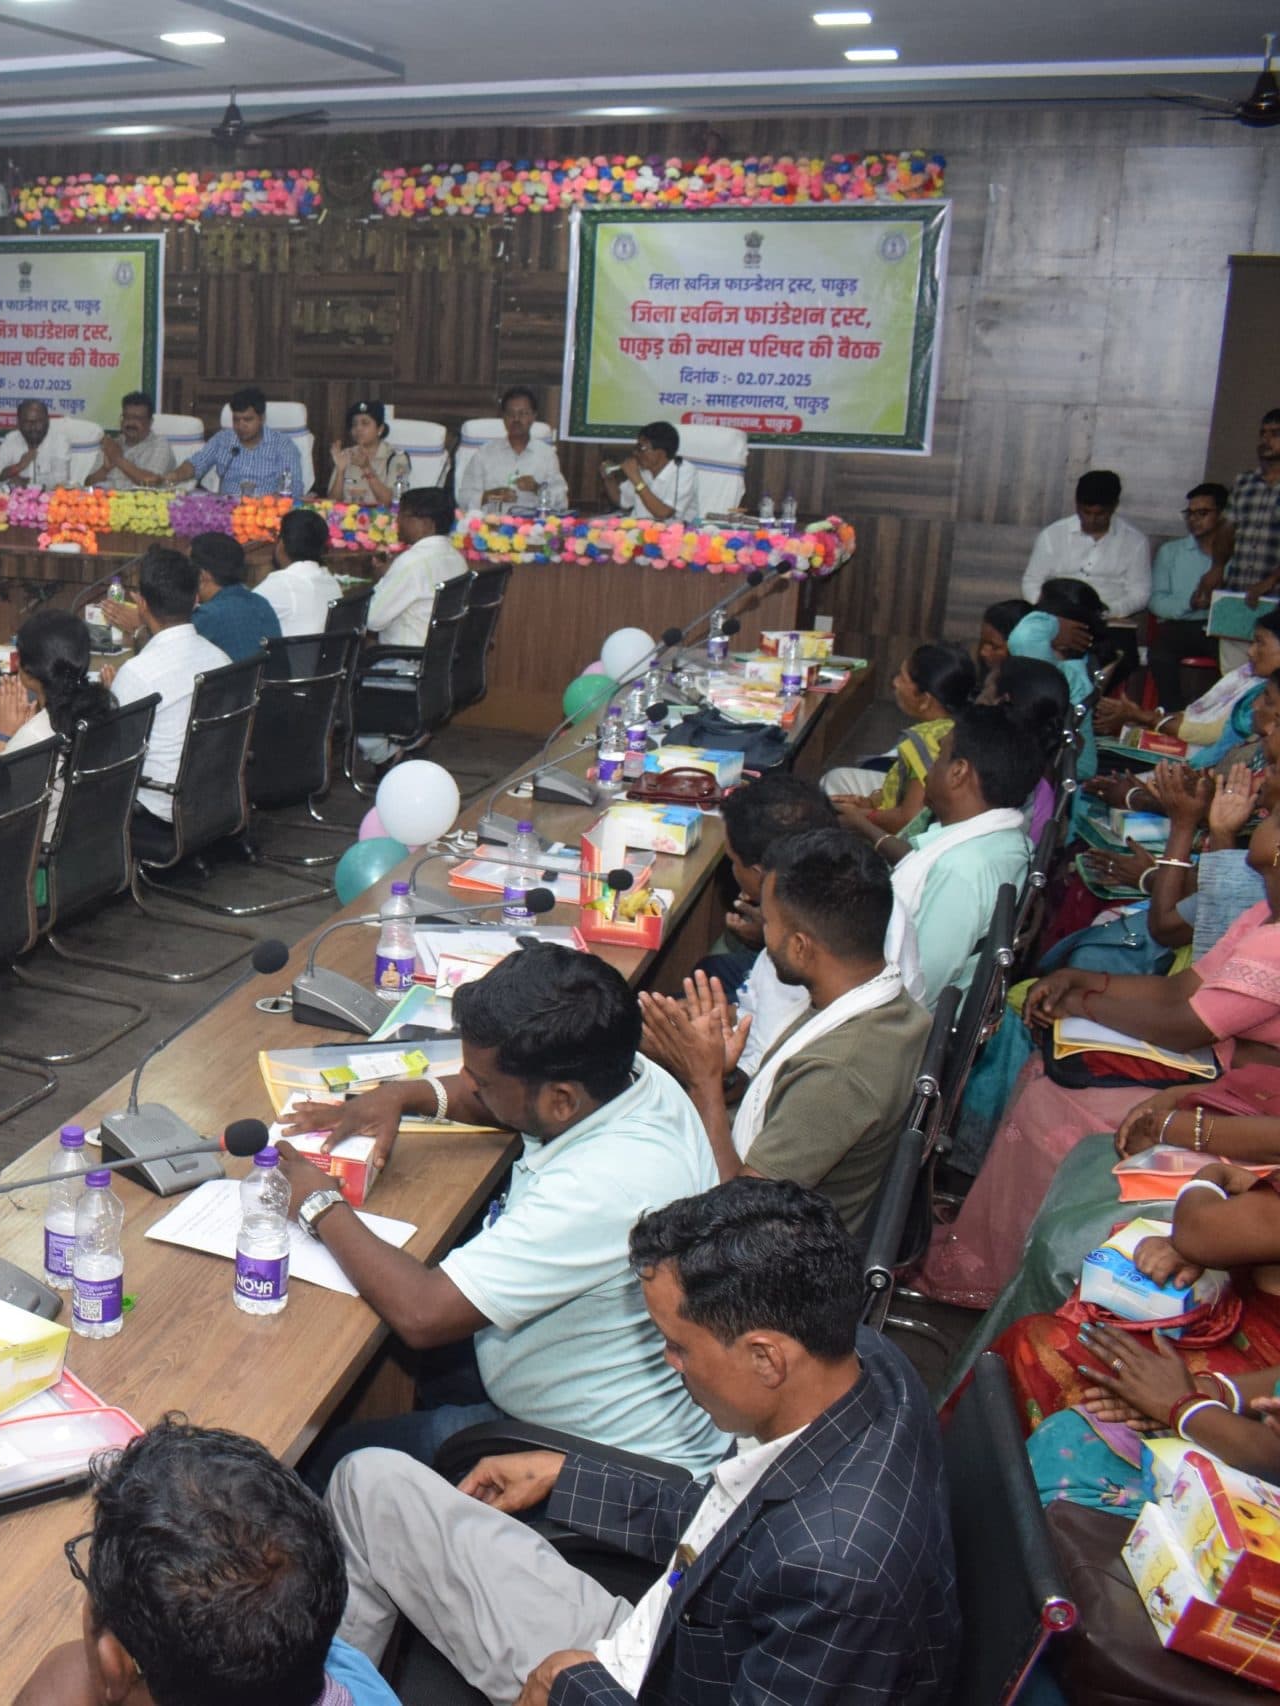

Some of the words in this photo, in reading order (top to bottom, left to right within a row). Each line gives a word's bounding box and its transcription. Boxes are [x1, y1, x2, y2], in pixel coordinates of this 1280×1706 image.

[649, 273, 680, 291] जिला
[684, 273, 720, 291] खनिज
[788, 277, 816, 294] ट्रस्ट,
[821, 277, 859, 297] पाकुड़
[631, 300, 674, 323] जिला
[681, 301, 738, 324] खनिज
[745, 302, 824, 326] फाउंडेशन
[831, 307, 872, 329] ट्रस्ट,
[22, 320, 79, 340] फाउंडेशन
[82, 324, 113, 342] ट्रस्ट,
[26, 347, 65, 367] परिषद
[68, 347, 85, 367] की
[89, 348, 120, 368] बैठक
[619, 336, 664, 361] पाकुड़
[669, 333, 691, 356] की
[696, 338, 744, 357] न्यास
[749, 334, 805, 358] परिषद
[809, 336, 833, 358] की
[838, 336, 882, 360] बैठक
[18, 378, 72, 391] 02.07.2025
[680, 366, 719, 385] दिनांक
[736, 372, 812, 387] 02.07.2025
[659, 392, 688, 406] स्थल
[706, 393, 789, 411] समाहरणालय,
[794, 397, 830, 415] पाकुड़
[236, 1273, 273, 1294] NOYA
